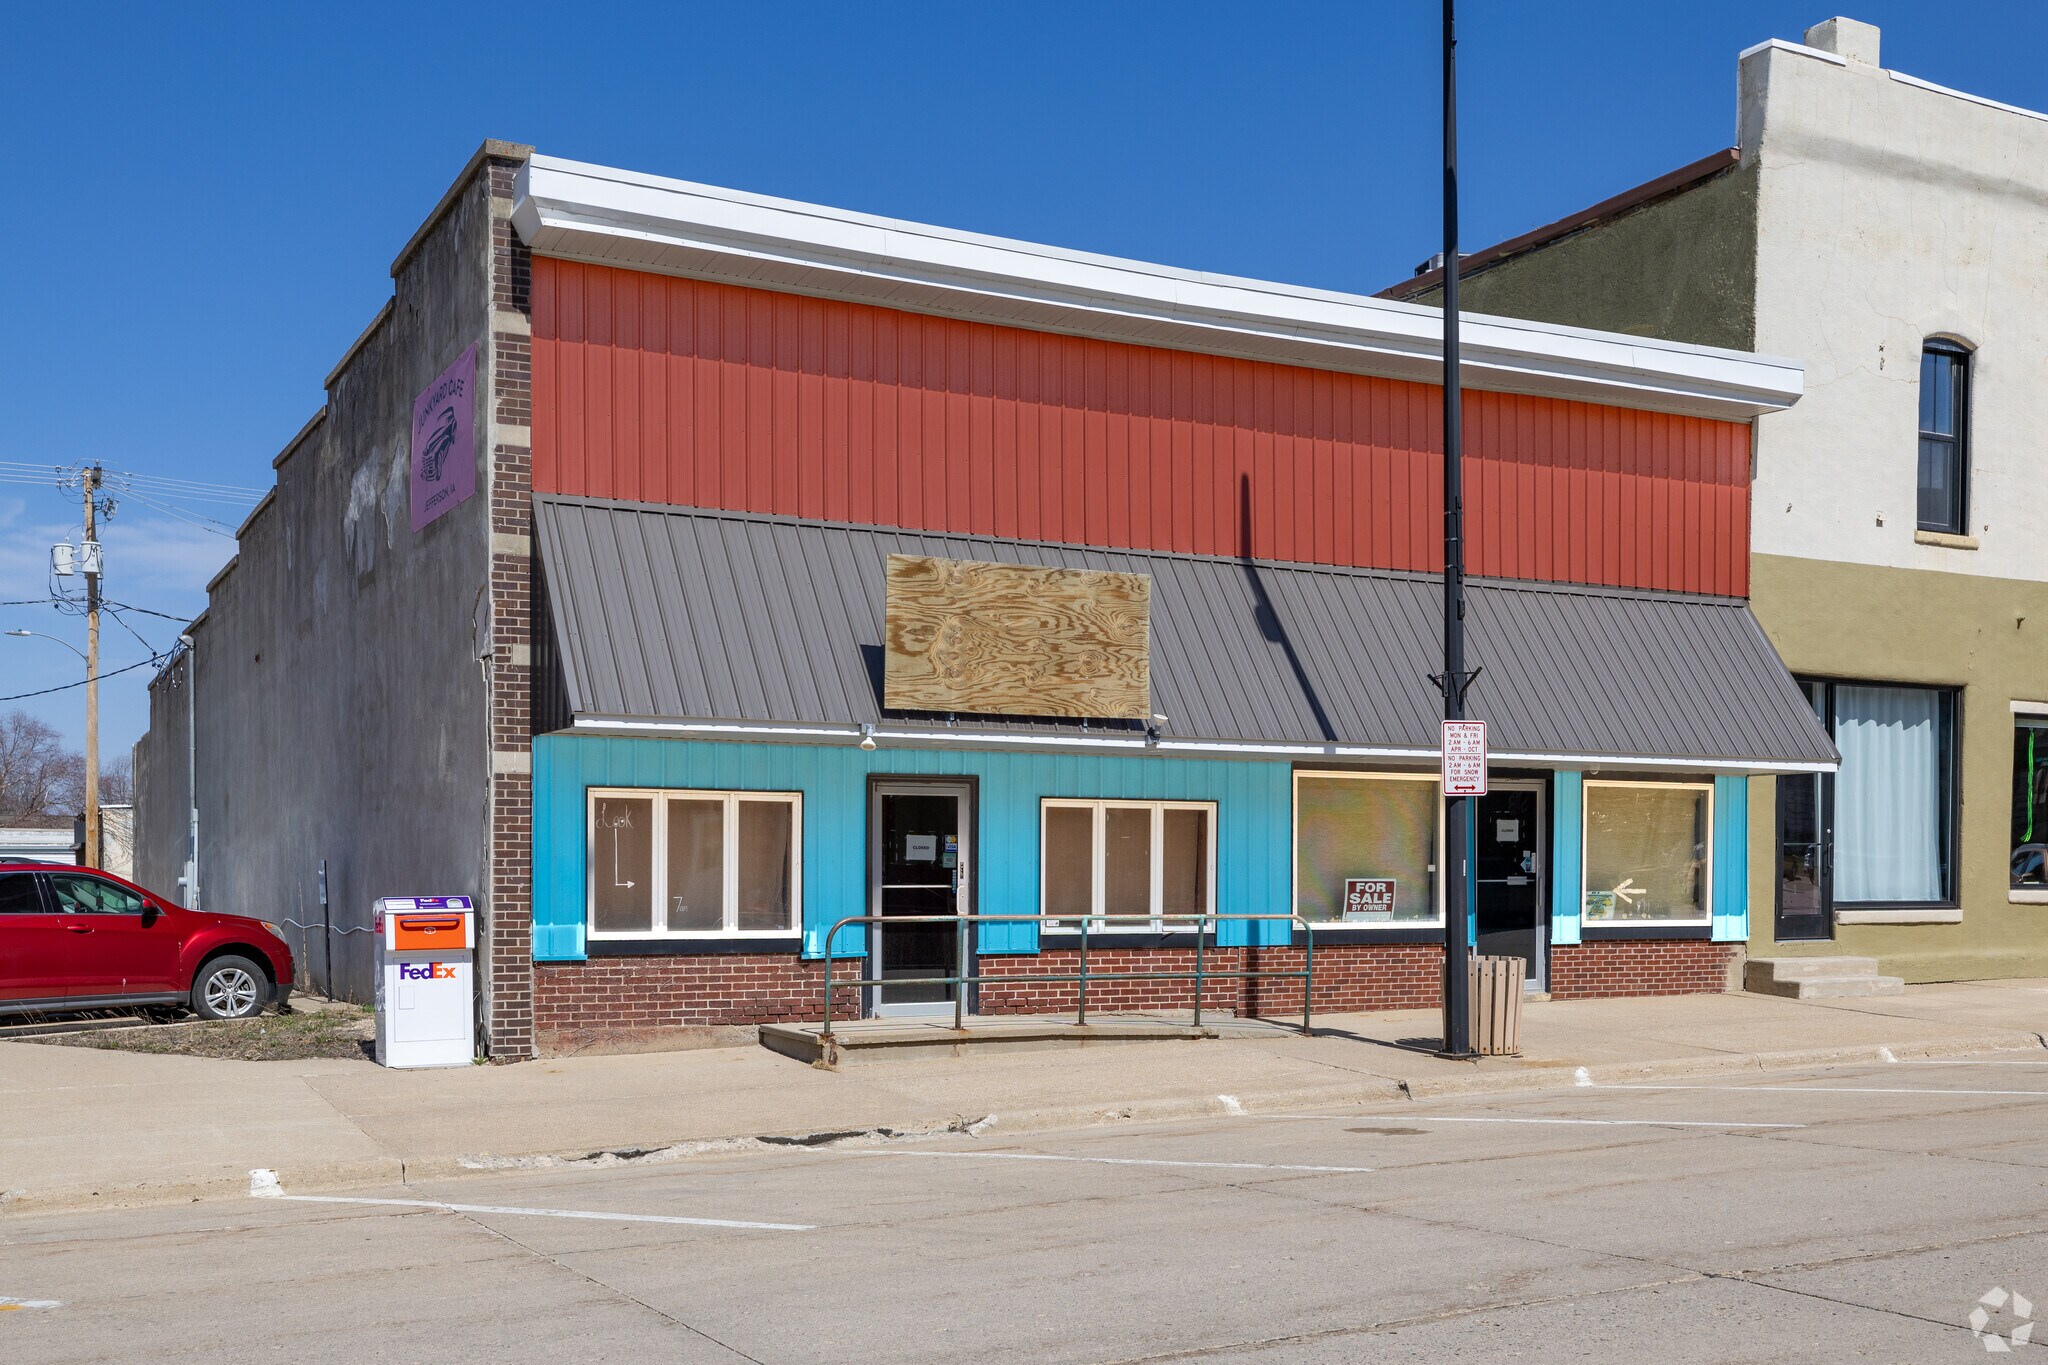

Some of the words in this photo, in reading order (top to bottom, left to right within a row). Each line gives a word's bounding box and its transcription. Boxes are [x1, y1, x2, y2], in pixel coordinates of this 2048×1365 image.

[418, 382, 447, 435] JUNKYARD
[448, 378, 465, 398] CAFE
[595, 802, 634, 829] Look
[1355, 882, 1387, 893] FOR
[1349, 892, 1392, 904] SALE
[399, 962, 456, 980] FedEx
